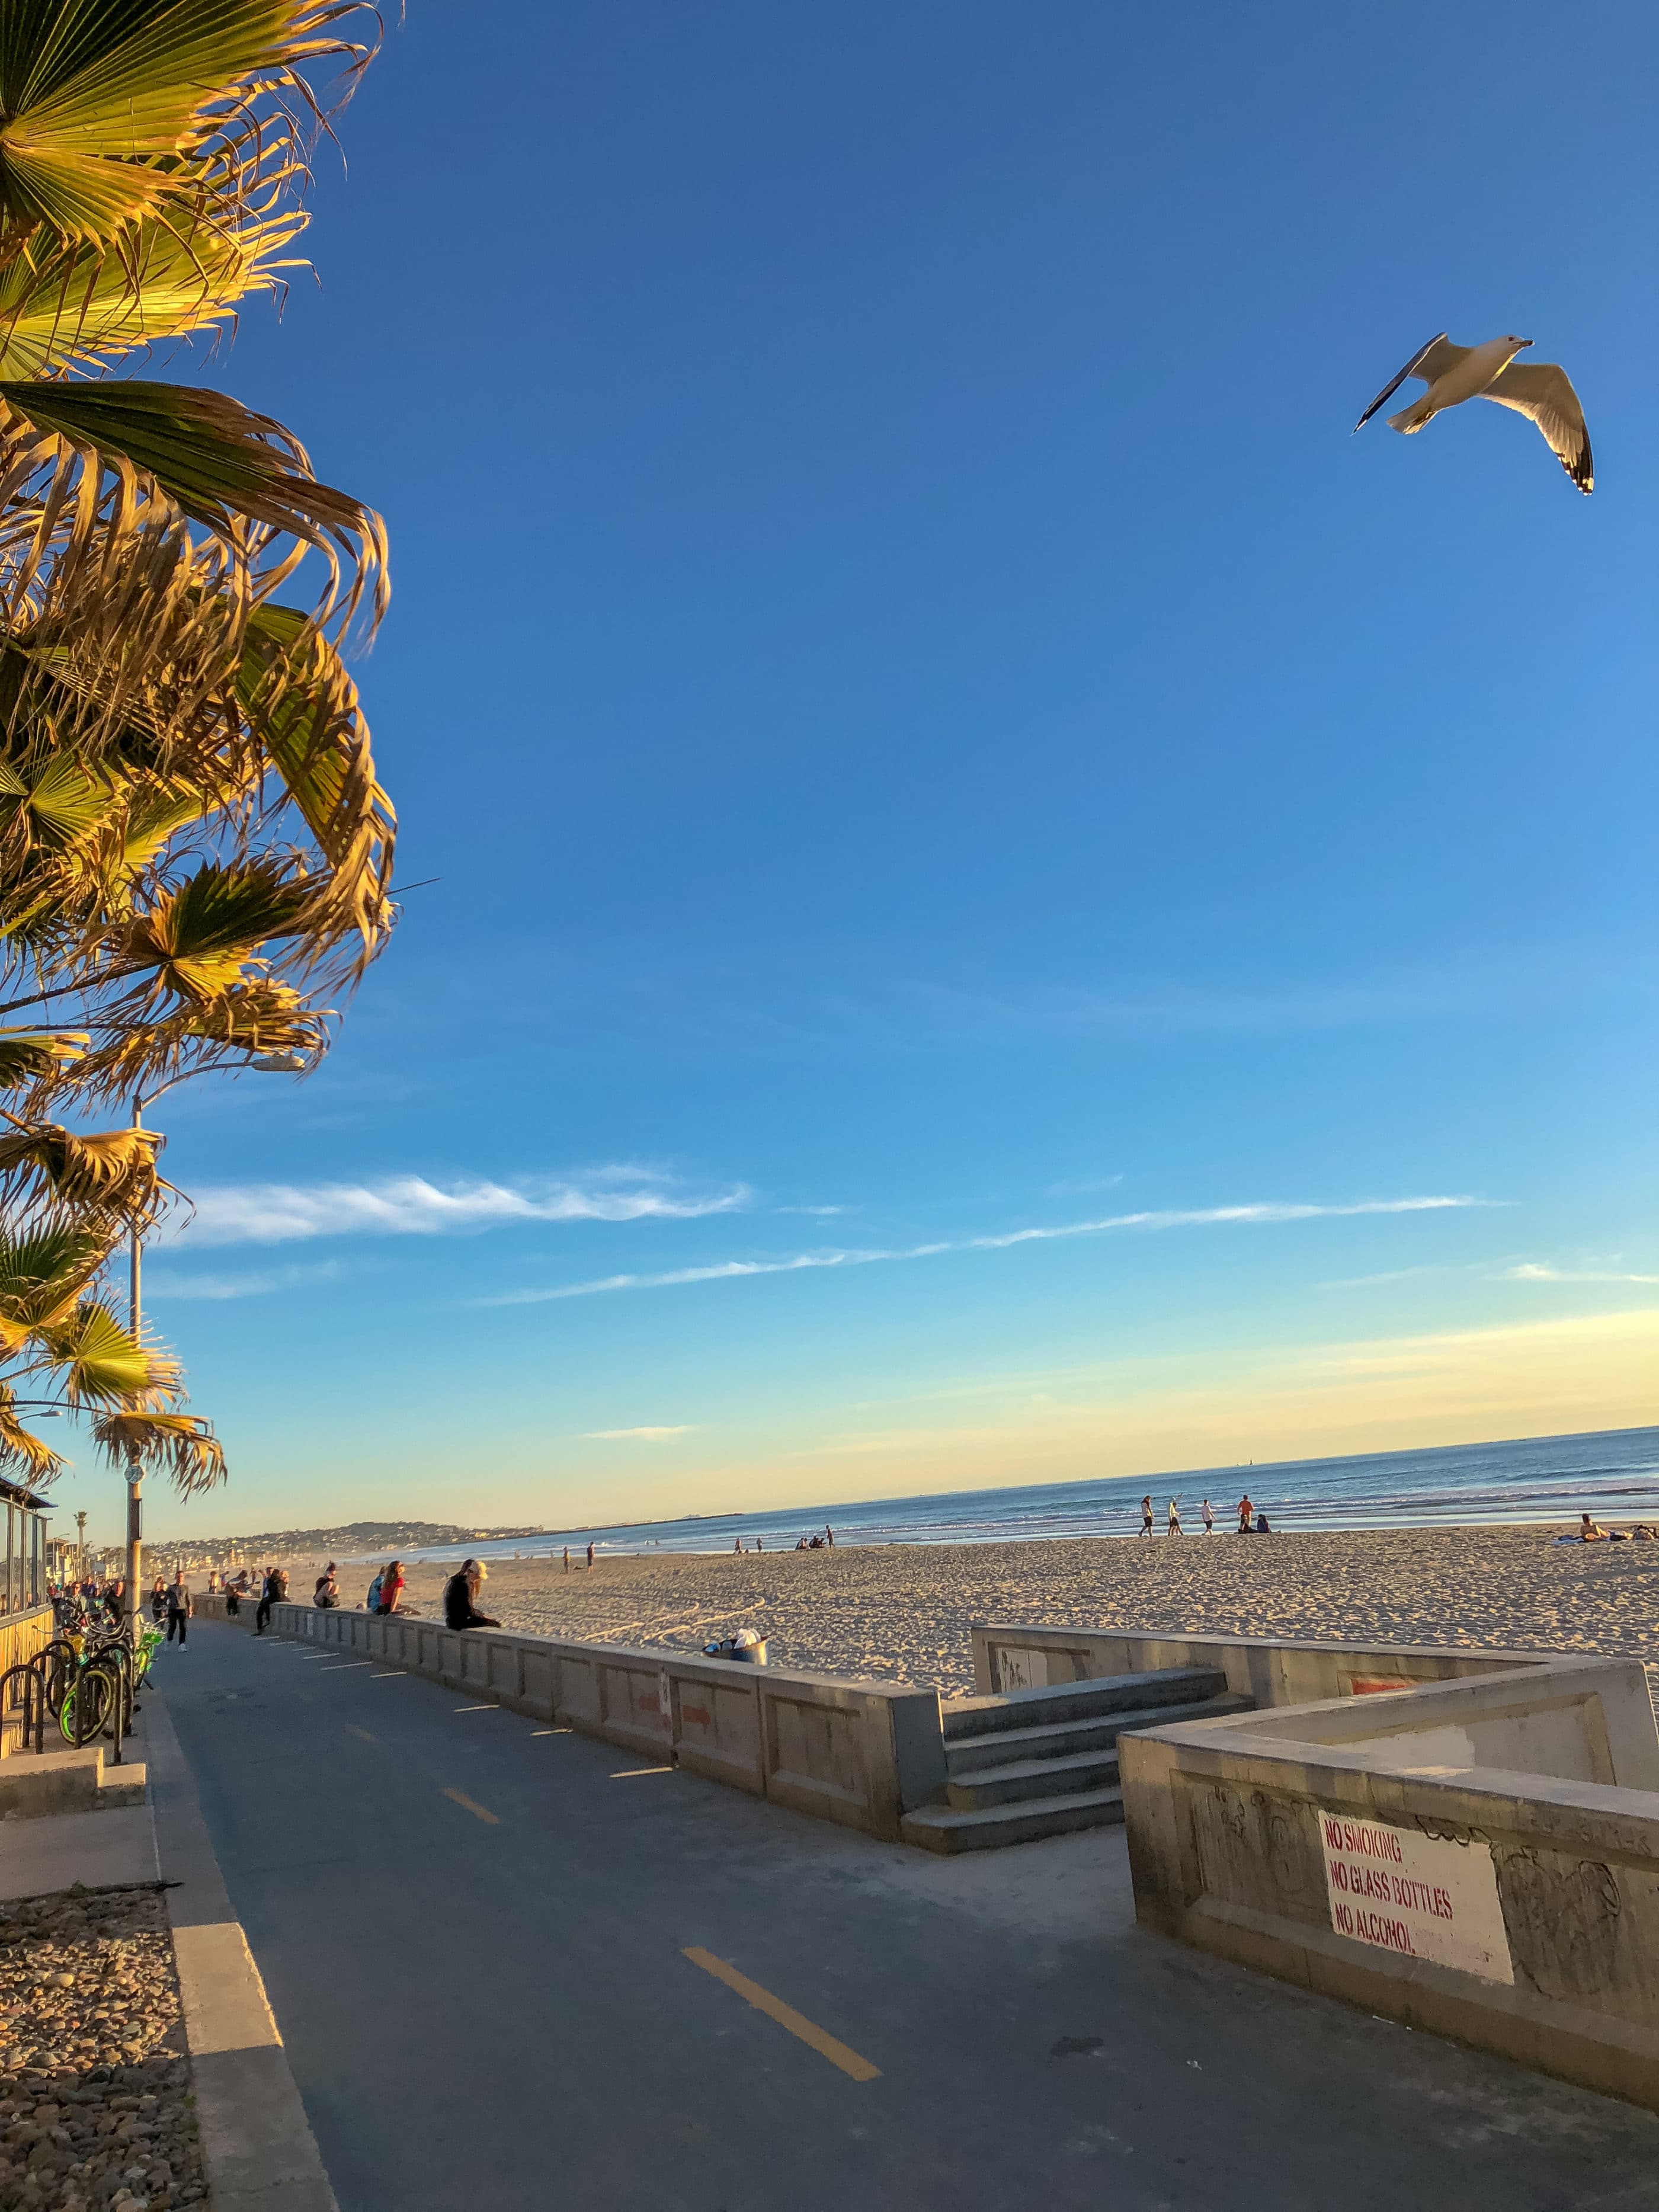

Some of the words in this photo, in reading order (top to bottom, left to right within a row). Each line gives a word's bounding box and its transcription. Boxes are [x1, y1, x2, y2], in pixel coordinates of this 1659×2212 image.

[1324, 1819, 1343, 1851] NO
[1344, 1824, 1402, 1864] SMOKING
[1330, 1860, 1347, 1891] NO
[1350, 1865, 1391, 1902] GLASS
[1392, 1875, 1453, 1920] BOTTLES
[1334, 1902, 1353, 1935] NO
[1356, 1908, 1415, 1954] ALCOHOL
